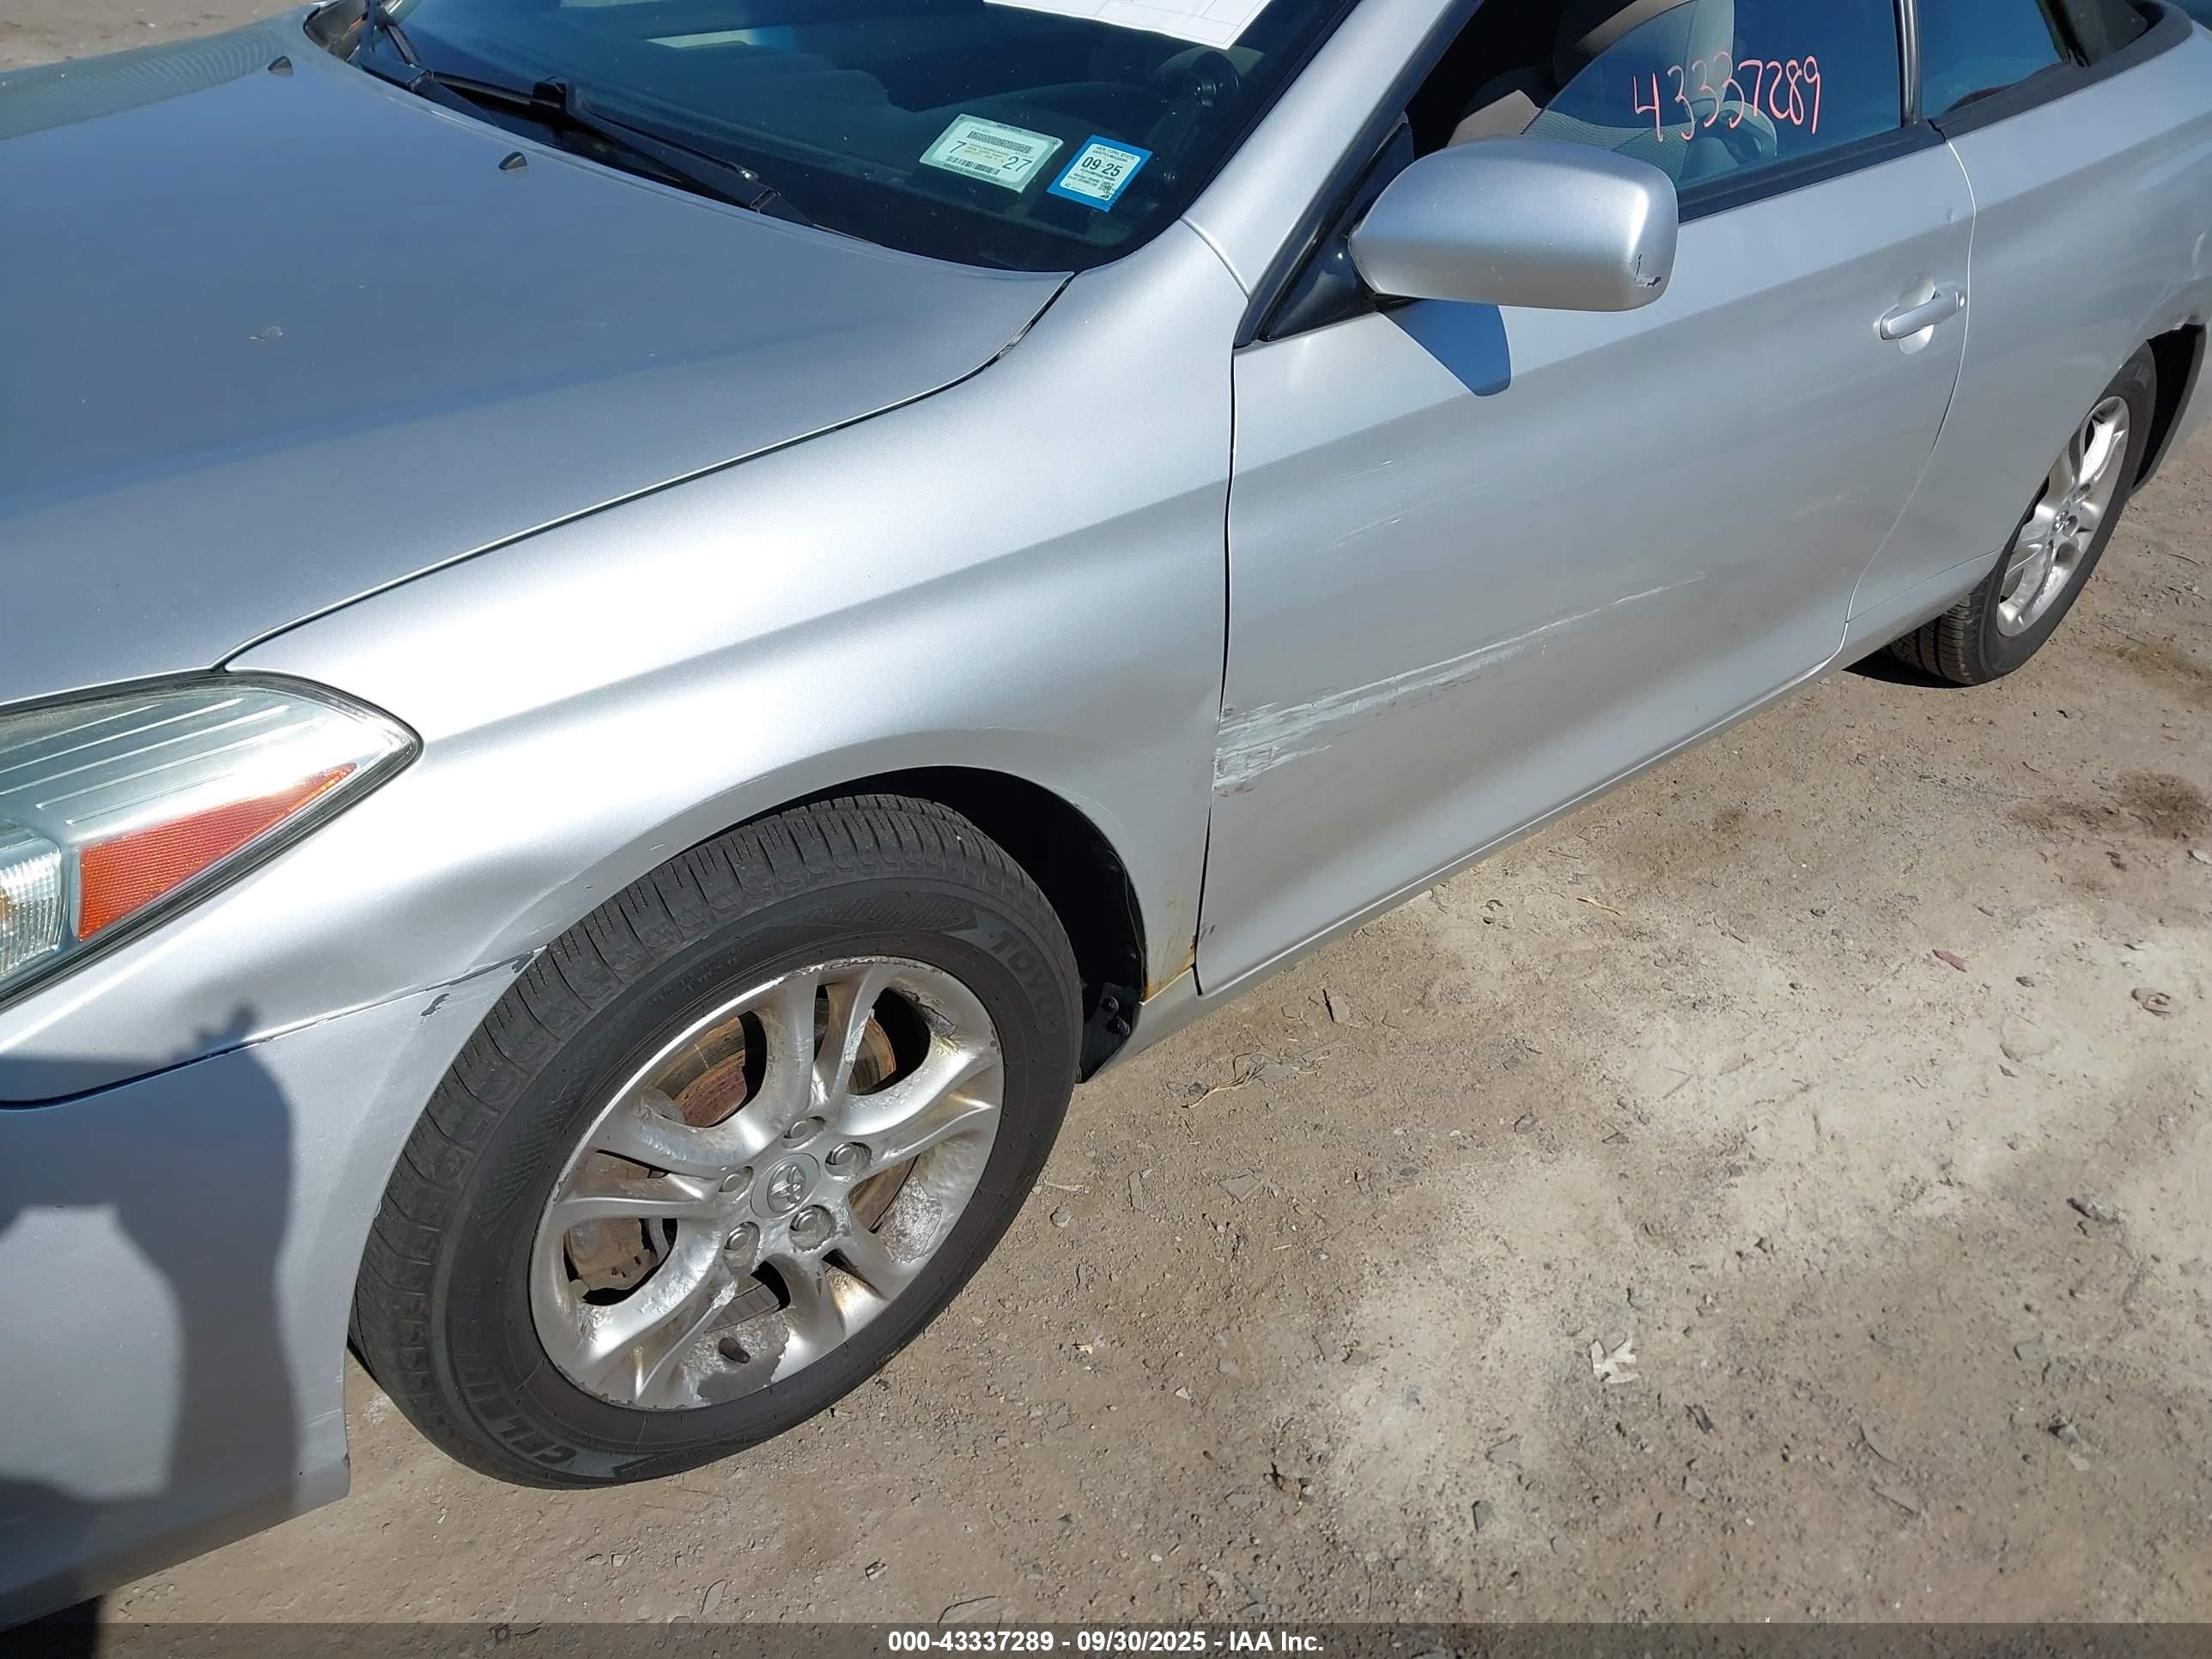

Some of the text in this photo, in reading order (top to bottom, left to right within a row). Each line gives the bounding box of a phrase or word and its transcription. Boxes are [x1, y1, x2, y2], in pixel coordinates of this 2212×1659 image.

[1632, 51, 1821, 142] 43337289
[949, 140, 967, 154] 7
[1001, 155, 1033, 173] 27
